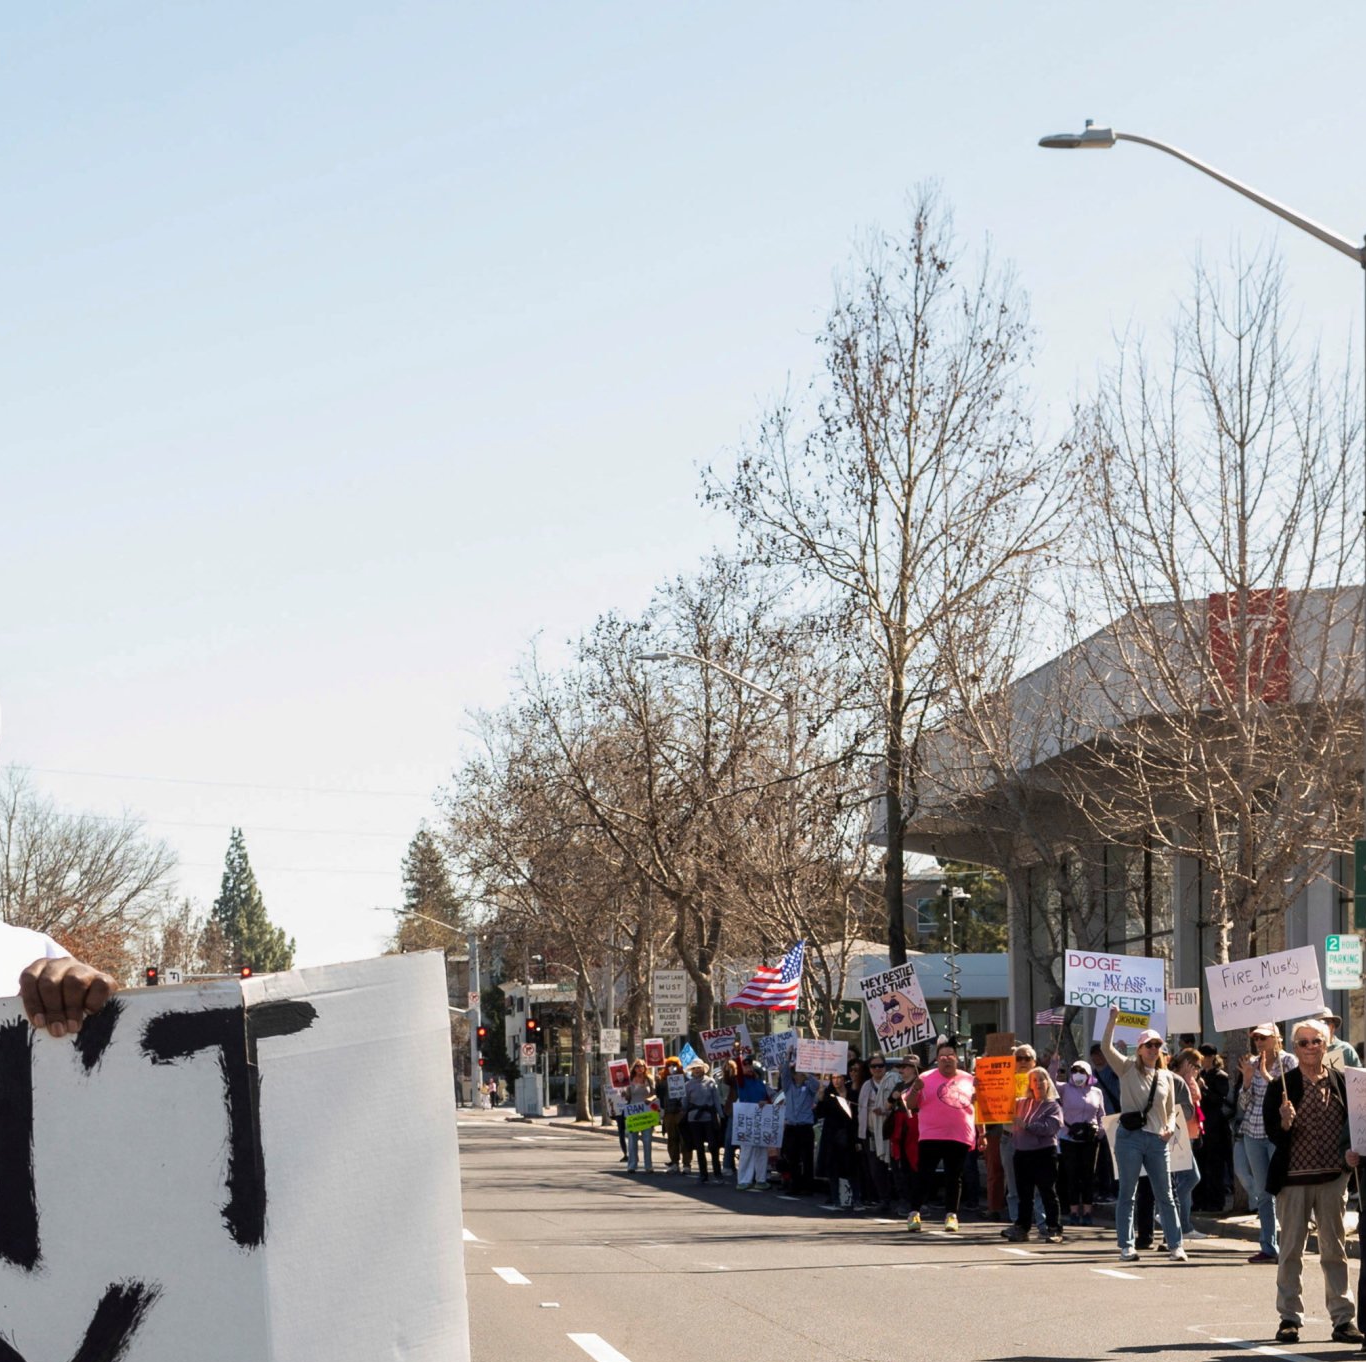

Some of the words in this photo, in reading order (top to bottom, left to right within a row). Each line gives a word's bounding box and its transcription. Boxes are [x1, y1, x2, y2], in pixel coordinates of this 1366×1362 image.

[1328, 937, 1338, 950] 2
[1341, 941, 1359, 949] HOUR
[1068, 954, 1122, 972] DOGE
[1329, 954, 1360, 964] PARKING
[860, 973, 882, 991] HEY
[884, 963, 915, 985] BESTIE!
[1104, 973, 1122, 985] MY
[1126, 975, 1147, 987] ASS
[865, 984, 888, 1001] LOSE
[887, 977, 912, 992] THAT
[1252, 982, 1271, 993] and
[1069, 991, 1156, 1013] POCKETS!
[1168, 992, 1198, 1006] FELON
[1221, 999, 1238, 1010] His
[1242, 993, 1276, 1007] Orange
[702, 1025, 737, 1041] FASCIST
